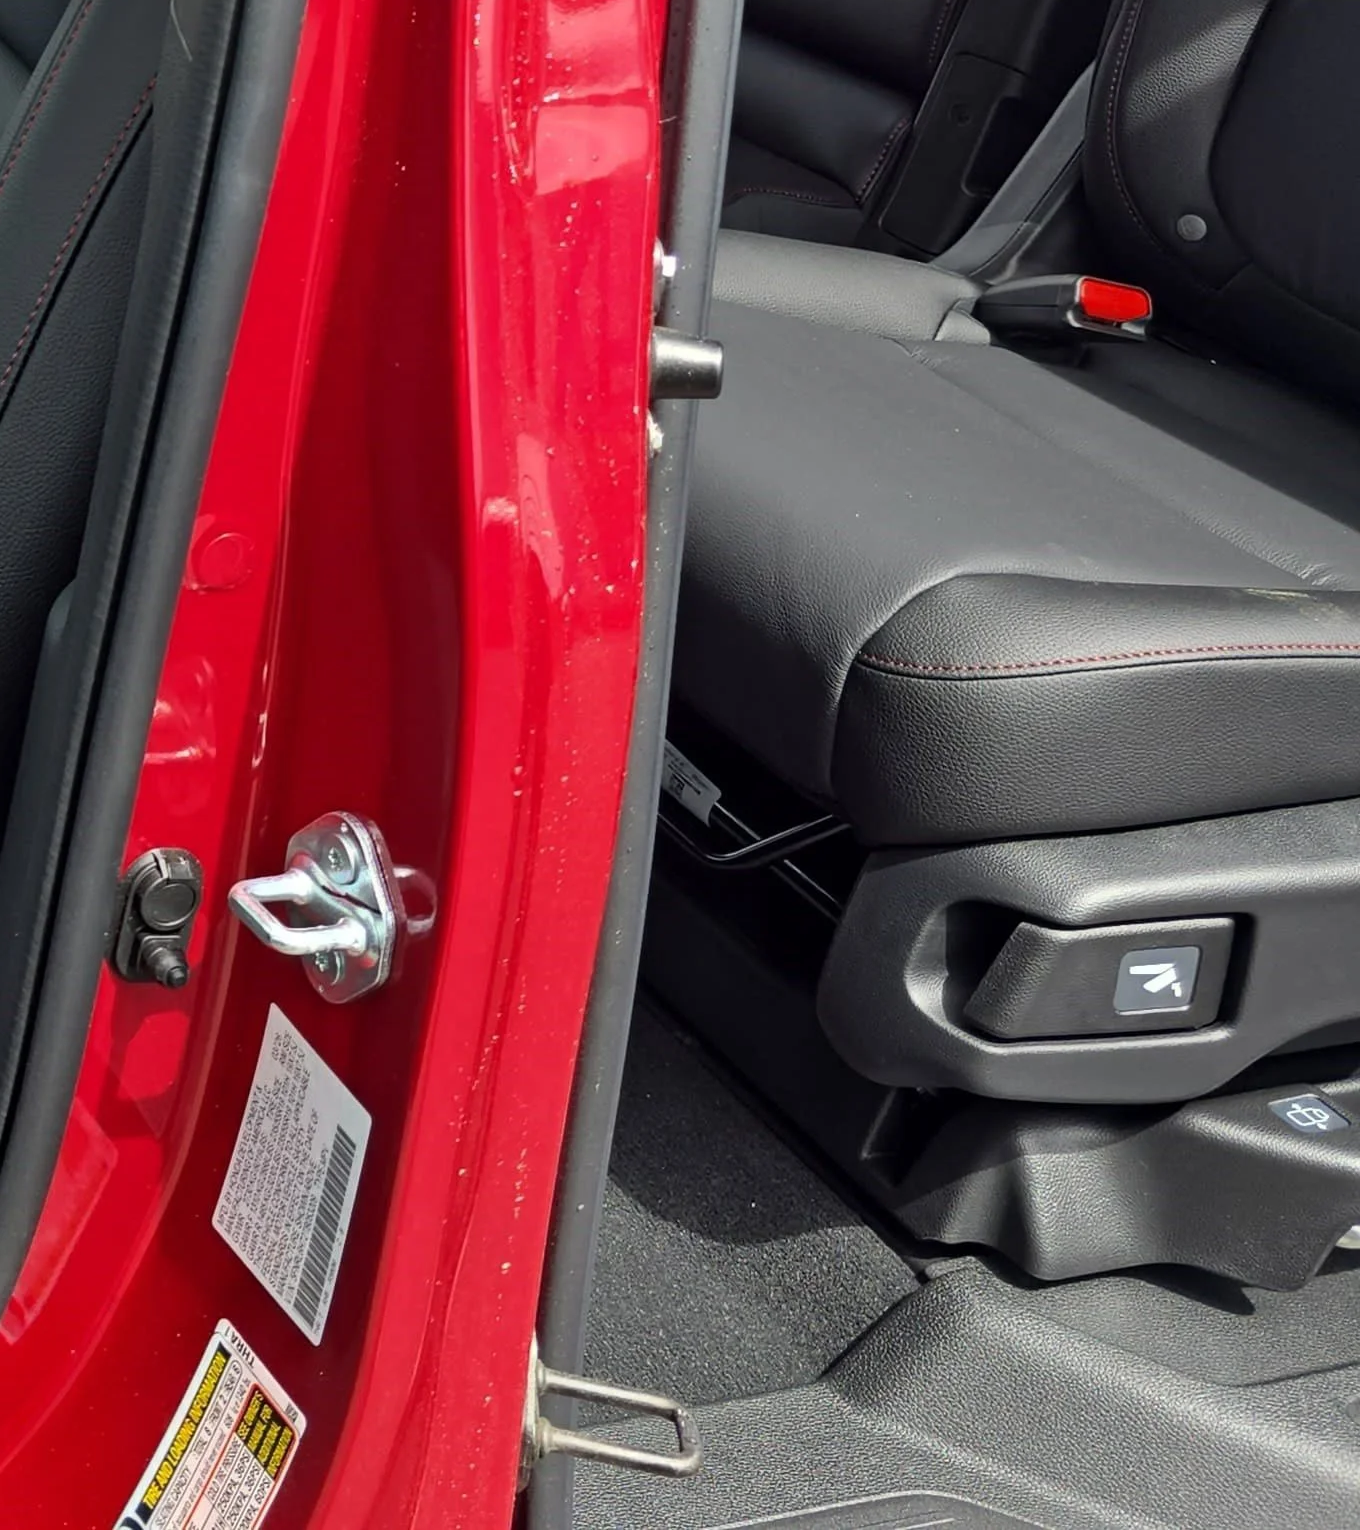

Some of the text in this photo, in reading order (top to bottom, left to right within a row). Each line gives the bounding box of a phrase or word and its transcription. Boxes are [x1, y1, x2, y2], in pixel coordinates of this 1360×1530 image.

[142, 1349, 226, 1511] TIRE AND LOADING INFORMATION
[267, 1426, 293, 1477] INFORMATION
[169, 1464, 192, 1503] CAPACITY
